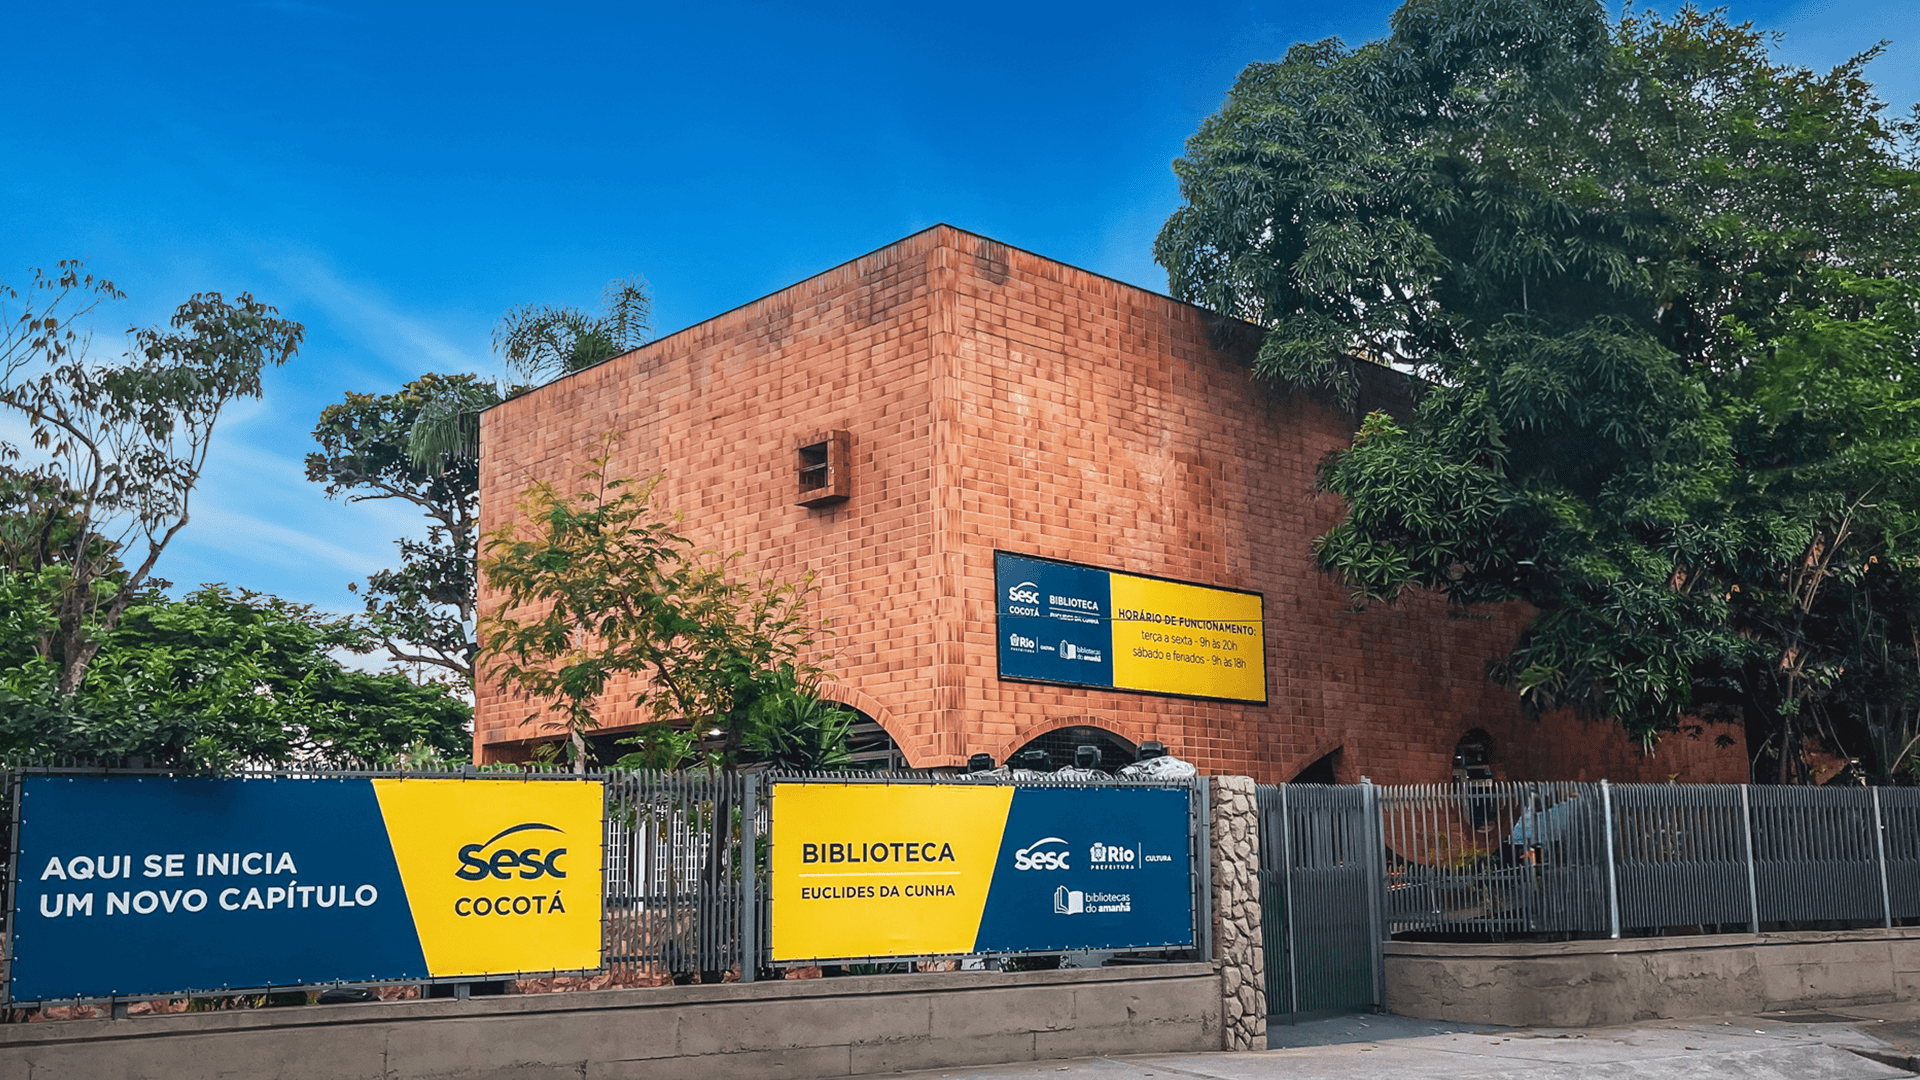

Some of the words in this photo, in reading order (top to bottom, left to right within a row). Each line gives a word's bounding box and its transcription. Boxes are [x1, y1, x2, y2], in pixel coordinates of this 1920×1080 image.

[1009, 605, 1040, 617] COCOTÁ
[1049, 594, 1099, 611] BIBLIOTECA
[1118, 608, 1162, 624] HORÁRIO
[1165, 614, 1176, 626] DE
[1179, 617, 1257, 637] FUNCIONAMENTO:
[1020, 637, 1035, 648] Rio
[1141, 630, 1162, 643] terça
[1164, 635, 1169, 643] a
[1171, 634, 1192, 646] sexta
[1200, 636, 1210, 647] 9h
[1222, 639, 1237, 651] 20h
[1132, 646, 1163, 660] sábado
[1165, 652, 1171, 660] e
[1173, 650, 1205, 665] feriados
[1211, 655, 1221, 666] 9h
[1234, 657, 1246, 669] 18h
[455, 829, 567, 881] Sesc
[802, 842, 955, 864] BIBLIOTECA
[1014, 841, 1070, 871] Sesc
[1107, 846, 1135, 862] Rio
[40, 855, 131, 880] AQUI
[143, 853, 185, 878] SE
[196, 852, 298, 876] INICIA
[40, 892, 93, 918] UM
[106, 888, 208, 916] NOVO
[218, 879, 378, 911] CAPÍTULO
[801, 886, 875, 899] EUCLIDES
[879, 885, 900, 898] DA
[904, 884, 956, 897] CUNHA
[1085, 892, 1131, 903] bibliotecas
[455, 889, 566, 917] COCOTÁ
[1085, 903, 1097, 913] do
[1098, 902, 1131, 913] amanhã
